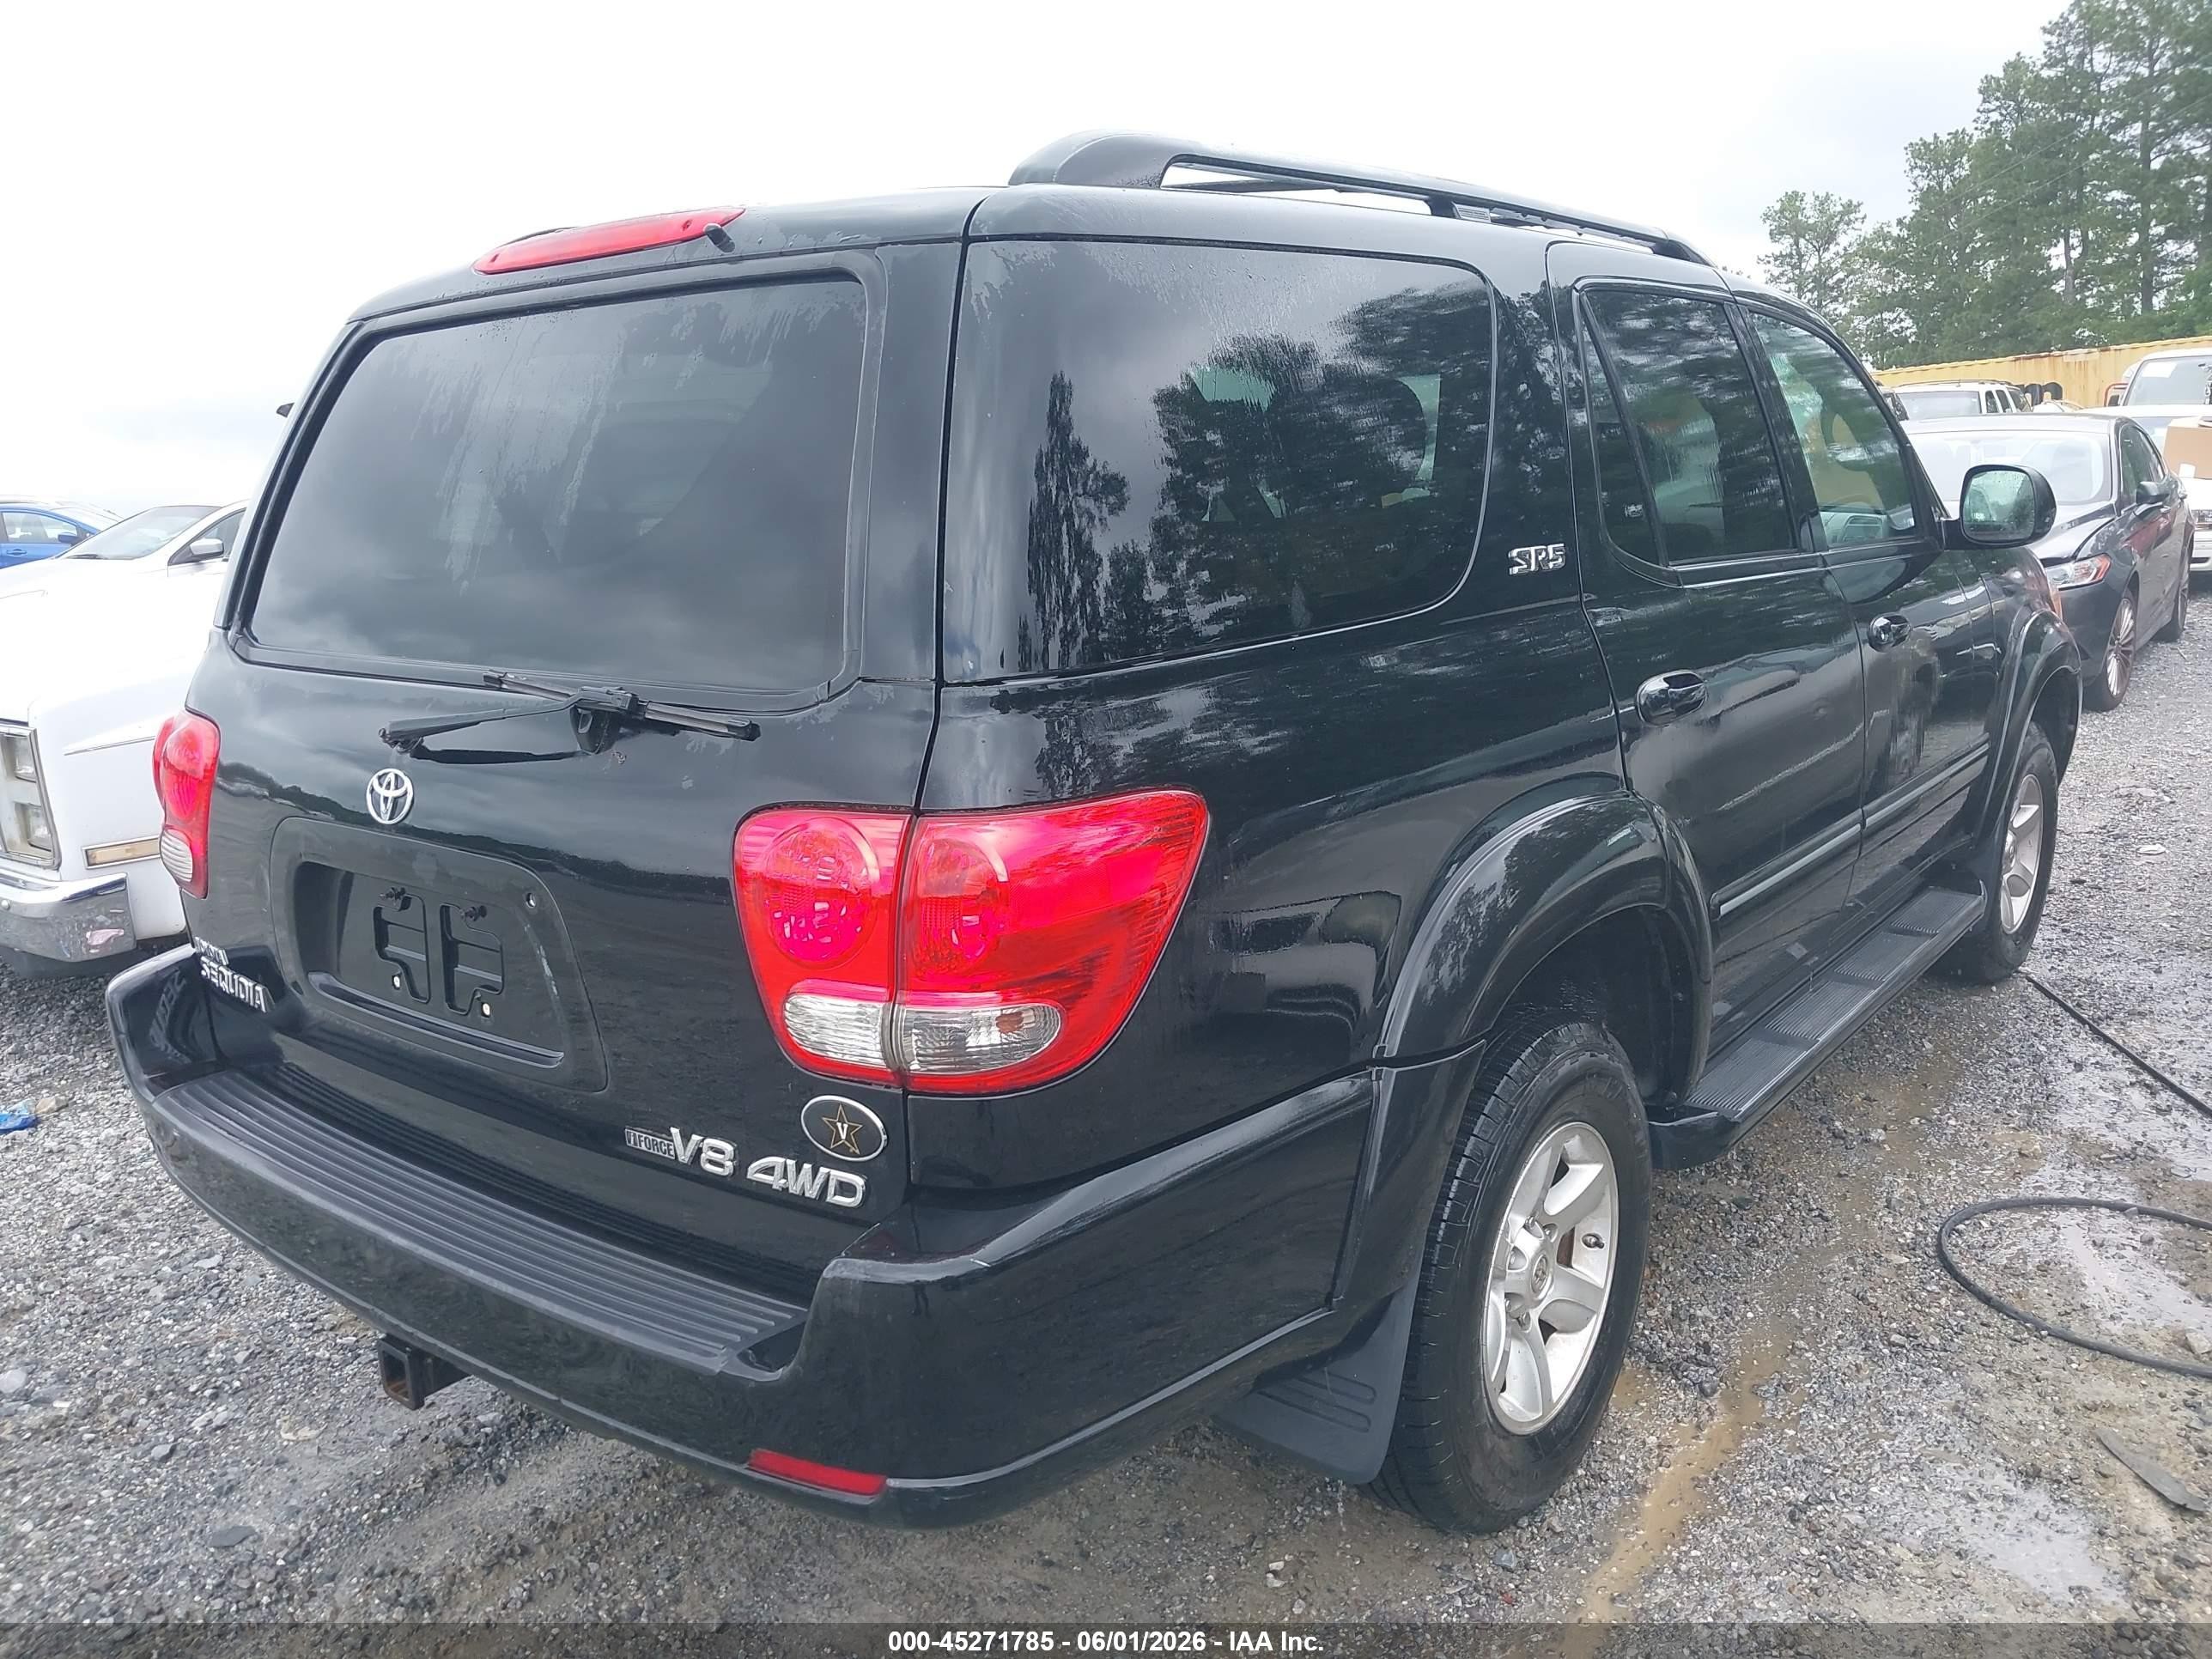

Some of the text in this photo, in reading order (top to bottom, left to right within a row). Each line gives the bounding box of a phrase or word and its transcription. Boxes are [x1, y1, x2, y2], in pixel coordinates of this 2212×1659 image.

[1508, 543, 1566, 575] SR5
[200, 956, 267, 1013] SEQUOIA
[670, 1127, 736, 1177] V8
[747, 1156, 866, 1208] 4WD
